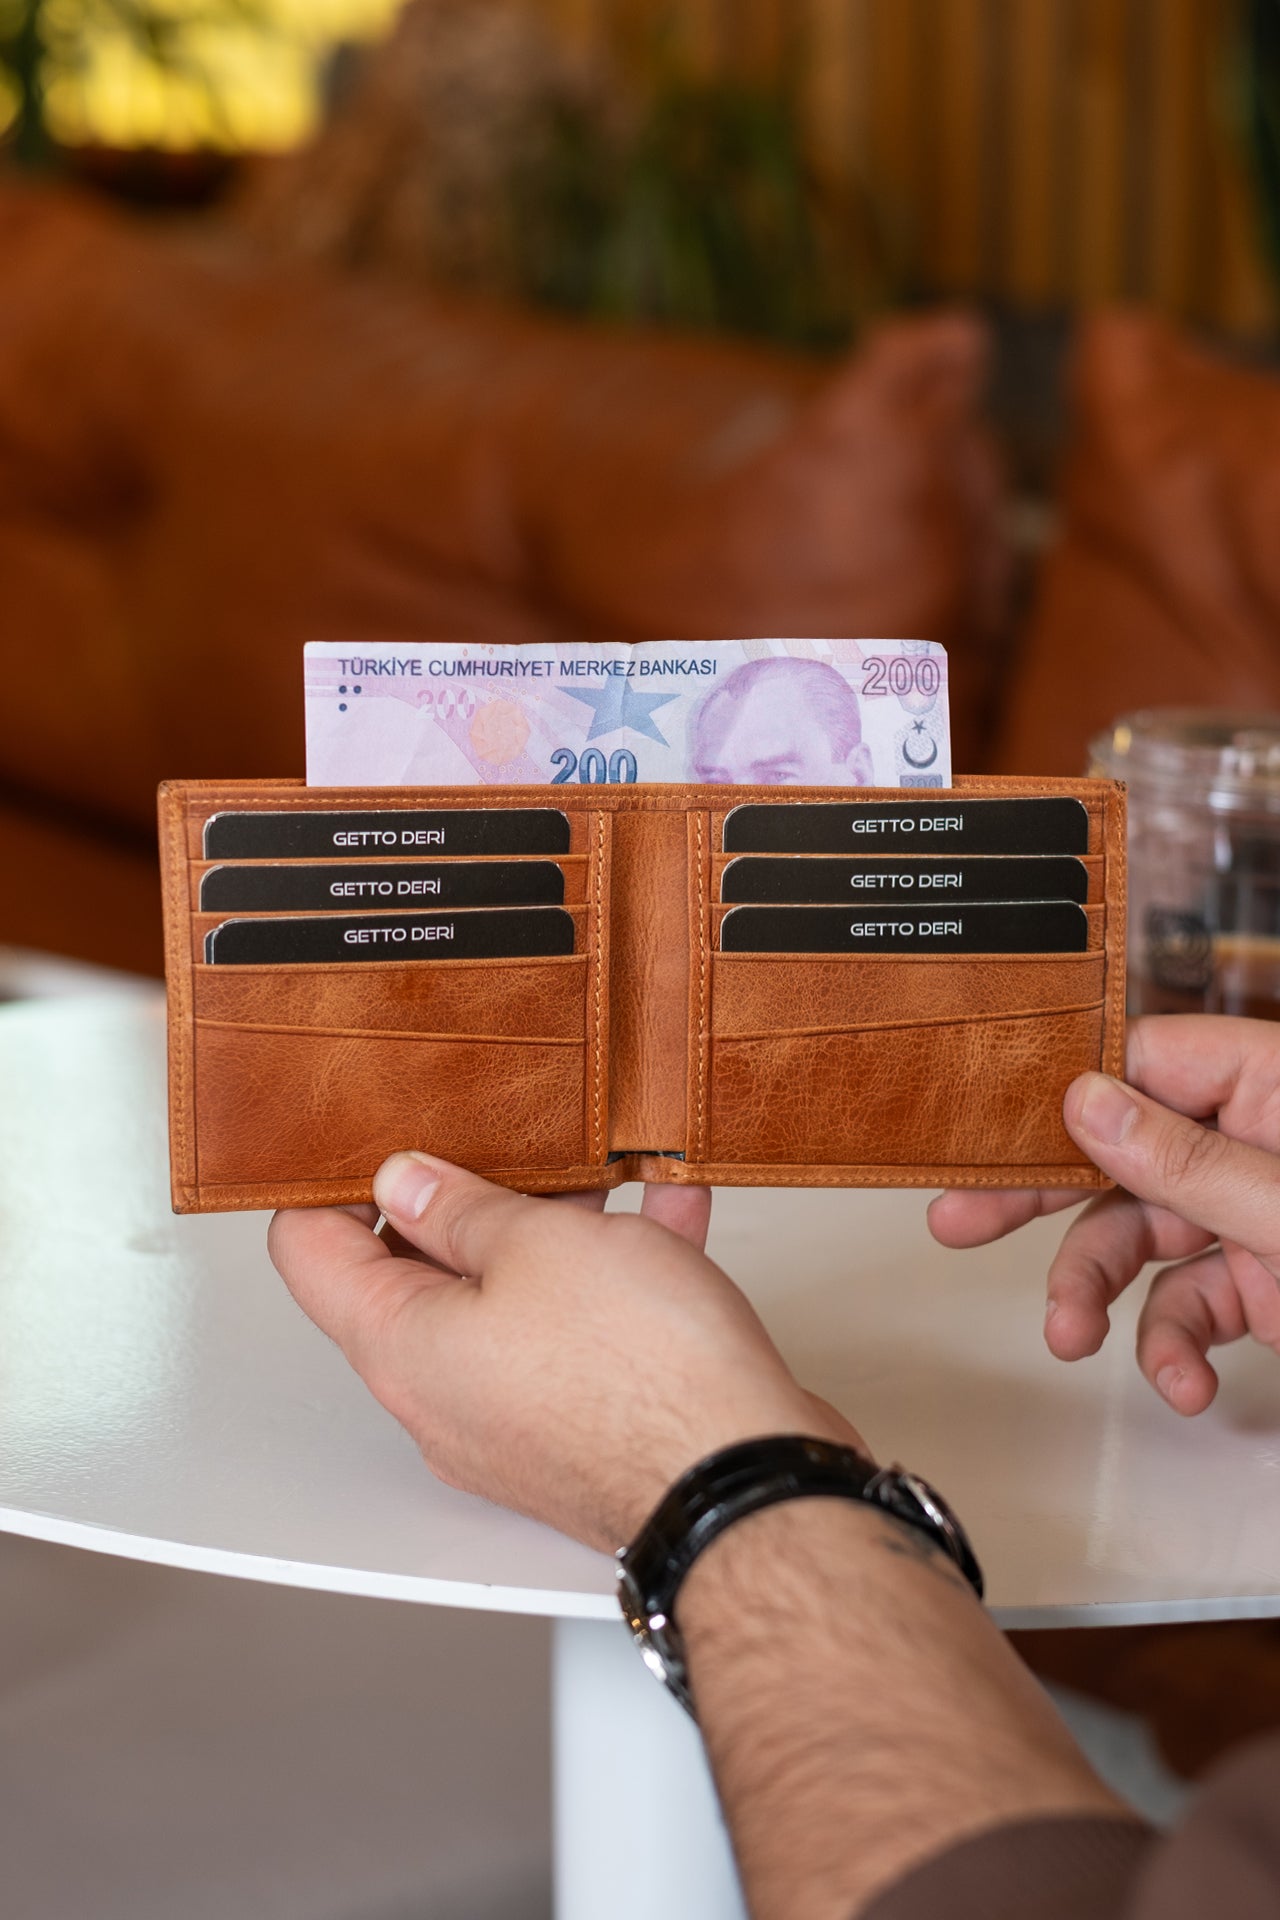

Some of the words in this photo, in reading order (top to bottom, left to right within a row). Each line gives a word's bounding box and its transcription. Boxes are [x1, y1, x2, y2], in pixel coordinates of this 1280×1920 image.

[338, 656, 423, 677] TÜRKİYE
[428, 658, 554, 677] CUMHURİYET
[560, 659, 636, 678] MERKEZ
[639, 659, 717, 676] BANKASI
[862, 657, 940, 696] 200
[415, 689, 476, 721] 200
[550, 747, 638, 785] 200
[852, 818, 916, 834] GETTO
[919, 814, 964, 833] DERİ
[332, 830, 398, 847] GETTO
[401, 827, 445, 846] DERİ
[329, 881, 394, 897] GETTO
[397, 877, 441, 896] DERİ
[850, 874, 915, 889] GETTO
[918, 871, 963, 888] DERİ
[343, 928, 407, 944] GETTO
[411, 923, 454, 941] DERİ
[850, 922, 915, 937] GETTO
[918, 919, 963, 936] DERİ
